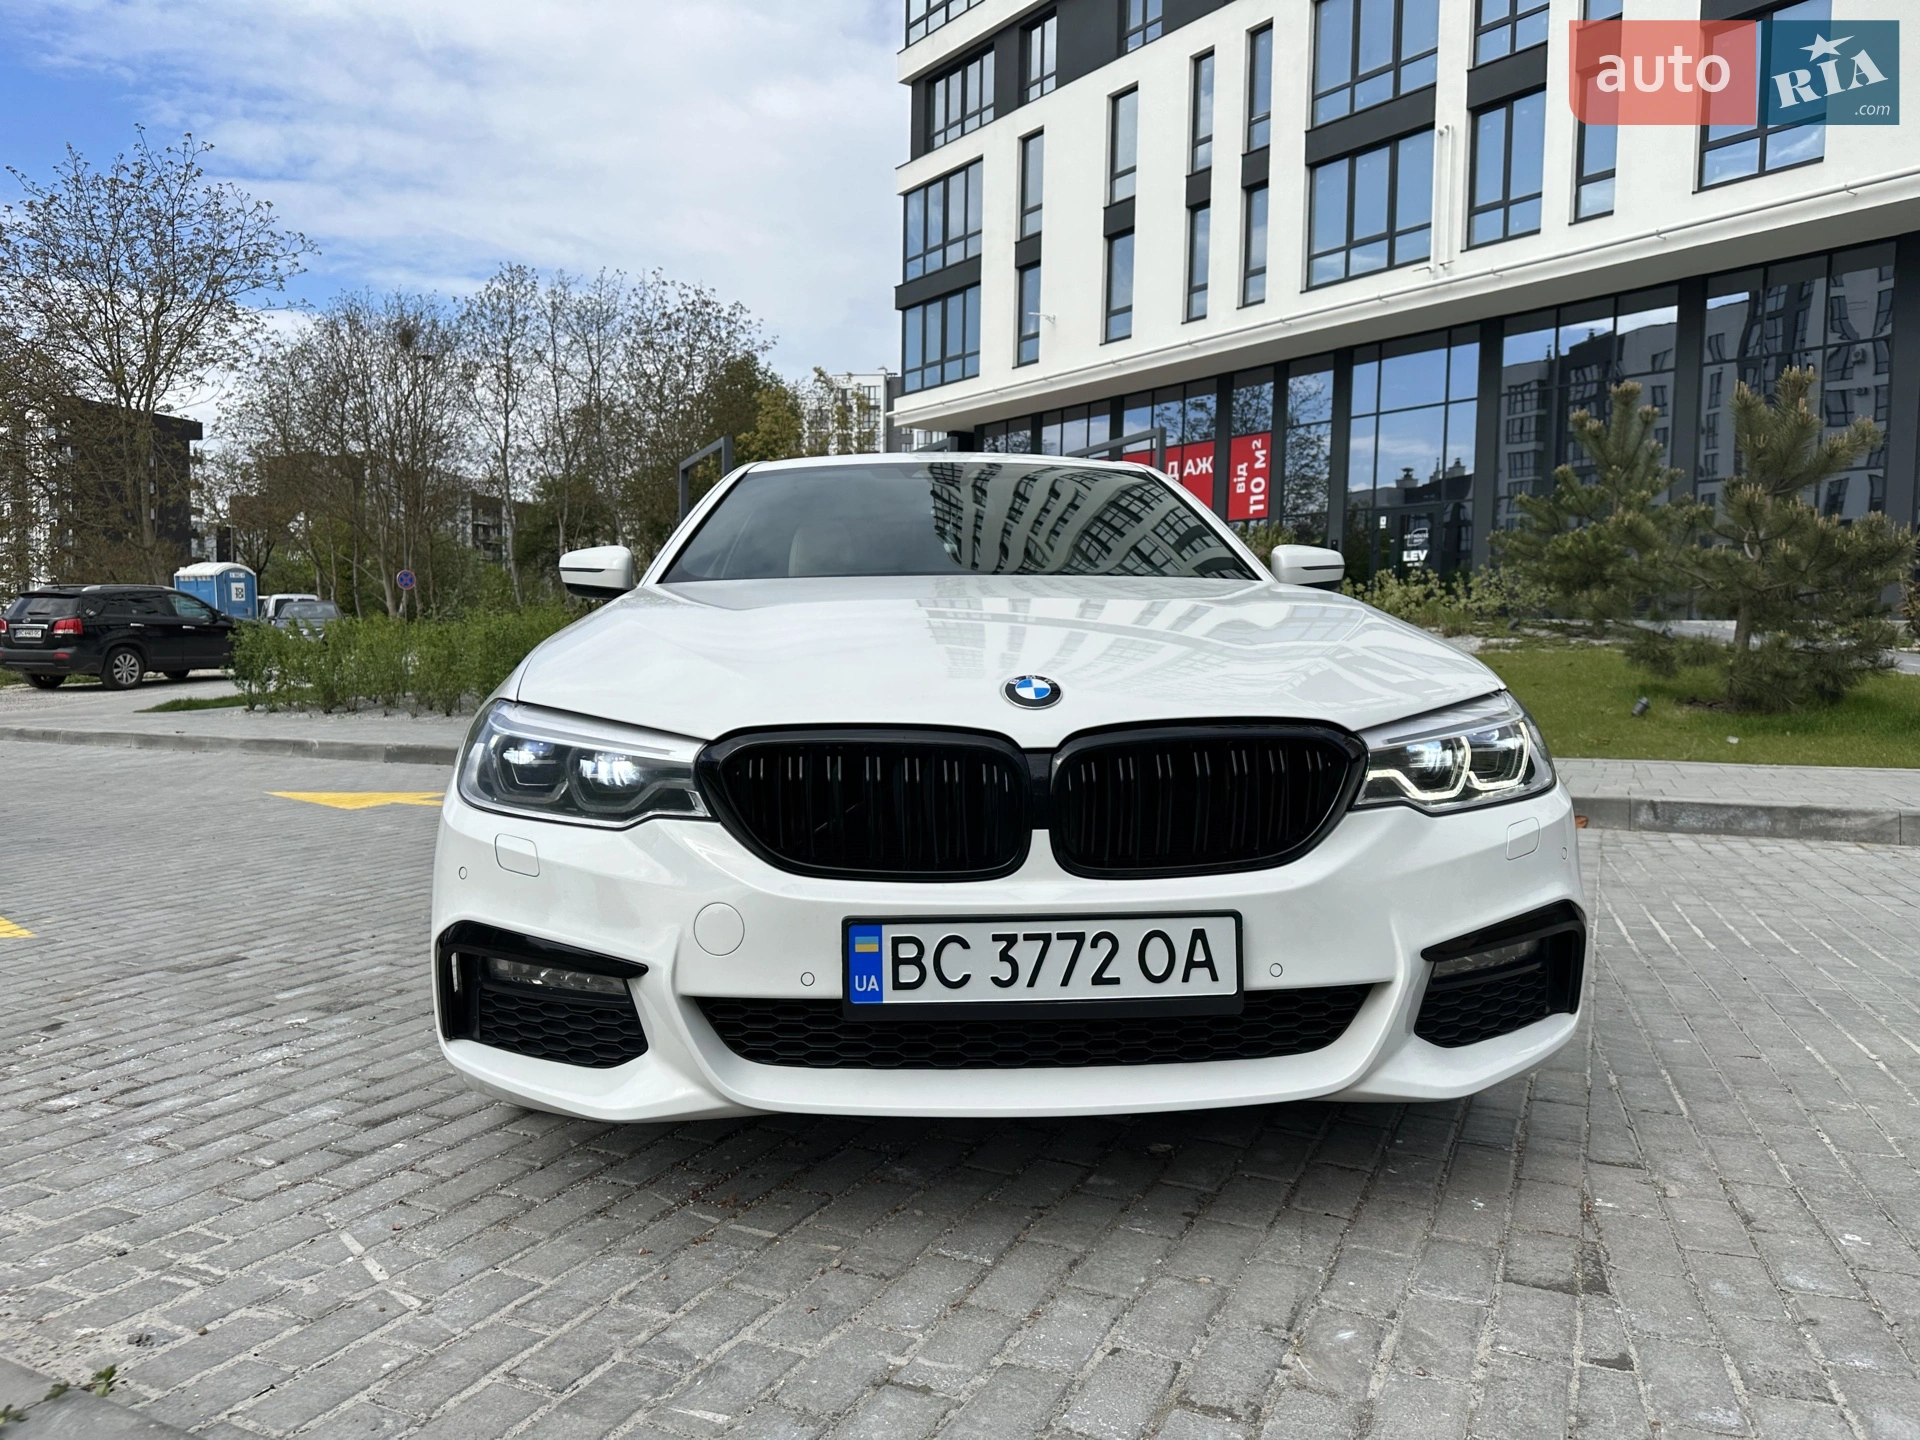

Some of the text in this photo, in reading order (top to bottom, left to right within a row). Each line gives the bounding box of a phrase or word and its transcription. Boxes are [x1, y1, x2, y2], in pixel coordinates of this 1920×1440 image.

[1233, 462, 1249, 494] від
[1249, 476, 1266, 514] 110
[1402, 549, 1428, 562] LEV
[890, 928, 1219, 991] BC 3772 OA
[854, 974, 880, 992] UA
